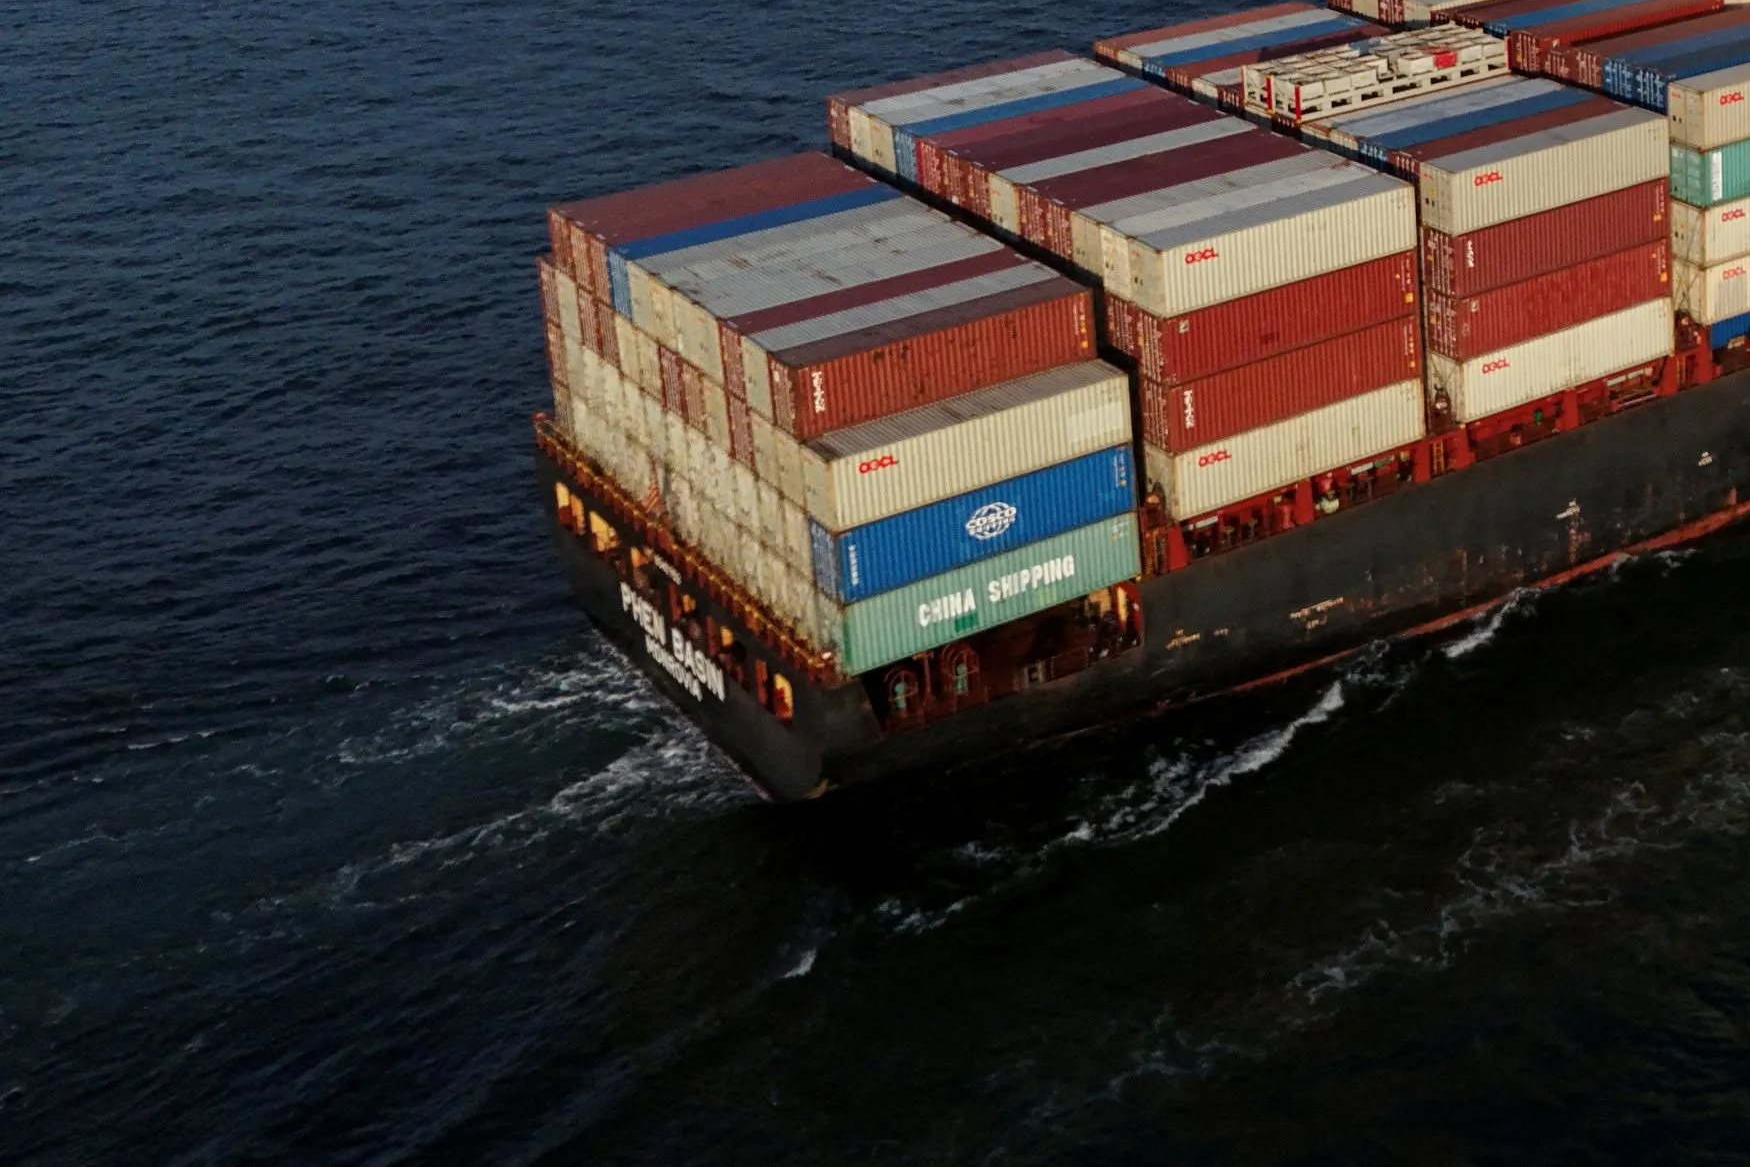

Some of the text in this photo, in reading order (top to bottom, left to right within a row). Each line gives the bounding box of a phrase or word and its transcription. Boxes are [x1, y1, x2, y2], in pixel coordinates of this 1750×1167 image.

[1719, 90, 1745, 106] OOCL
[1473, 170, 1504, 188] OOCL
[1720, 208, 1746, 223] OOCL
[1184, 247, 1220, 266] OOCL
[1721, 266, 1747, 280] OOCL
[1481, 357, 1511, 375] OOCL
[858, 454, 899, 475] OOCL
[1198, 449, 1232, 468] OOCL
[965, 507, 1016, 529] COSCO
[918, 554, 1075, 627] CHINA SHIPPING
[620, 581, 726, 703] PHEN BASIN
